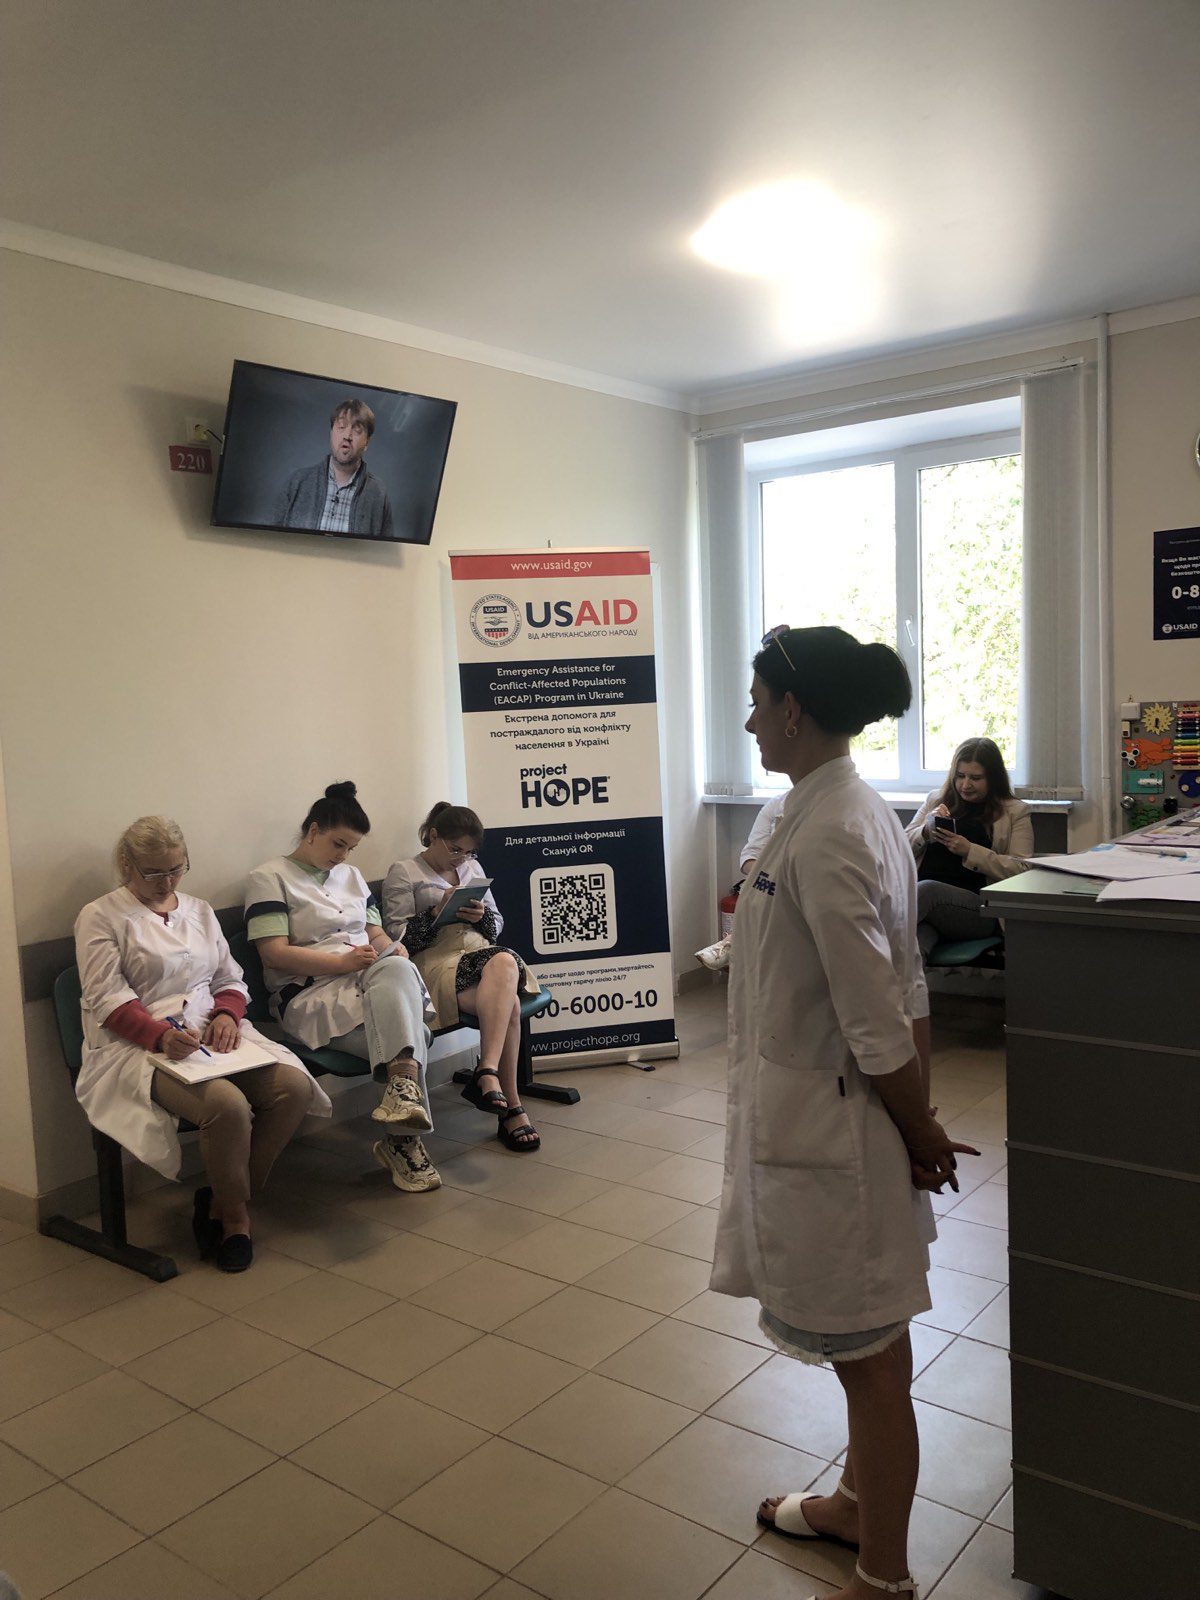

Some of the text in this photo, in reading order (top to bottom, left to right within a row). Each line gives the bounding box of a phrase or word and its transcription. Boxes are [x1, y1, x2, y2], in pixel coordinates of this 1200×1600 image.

[511, 559, 593, 573] www.usaid.gov
[526, 599, 638, 628] USAID
[528, 629, 638, 640] ВІД АМЕРИКАНСЬКОГО НАРОДУ
[496, 663, 616, 677] Emergency Assistance for
[489, 677, 626, 691] Conflict-Affected Populations
[494, 690, 624, 705] (EACAP) Program in Ukraine
[504, 710, 616, 724] Екстрена допомога для
[490, 723, 631, 739] постраждалого від конфлікту
[515, 740, 565, 750] населення
[575, 737, 609, 748] Україні
[520, 763, 567, 780] project
[521, 776, 609, 809] HOPE
[505, 829, 626, 846] Для детальної інформації
[542, 844, 593, 856] Скануй QR
[574, 978, 594, 986] гарячу
[613, 974, 627, 982] 24/7
[531, 1031, 640, 1052] ww.projecthope.org
